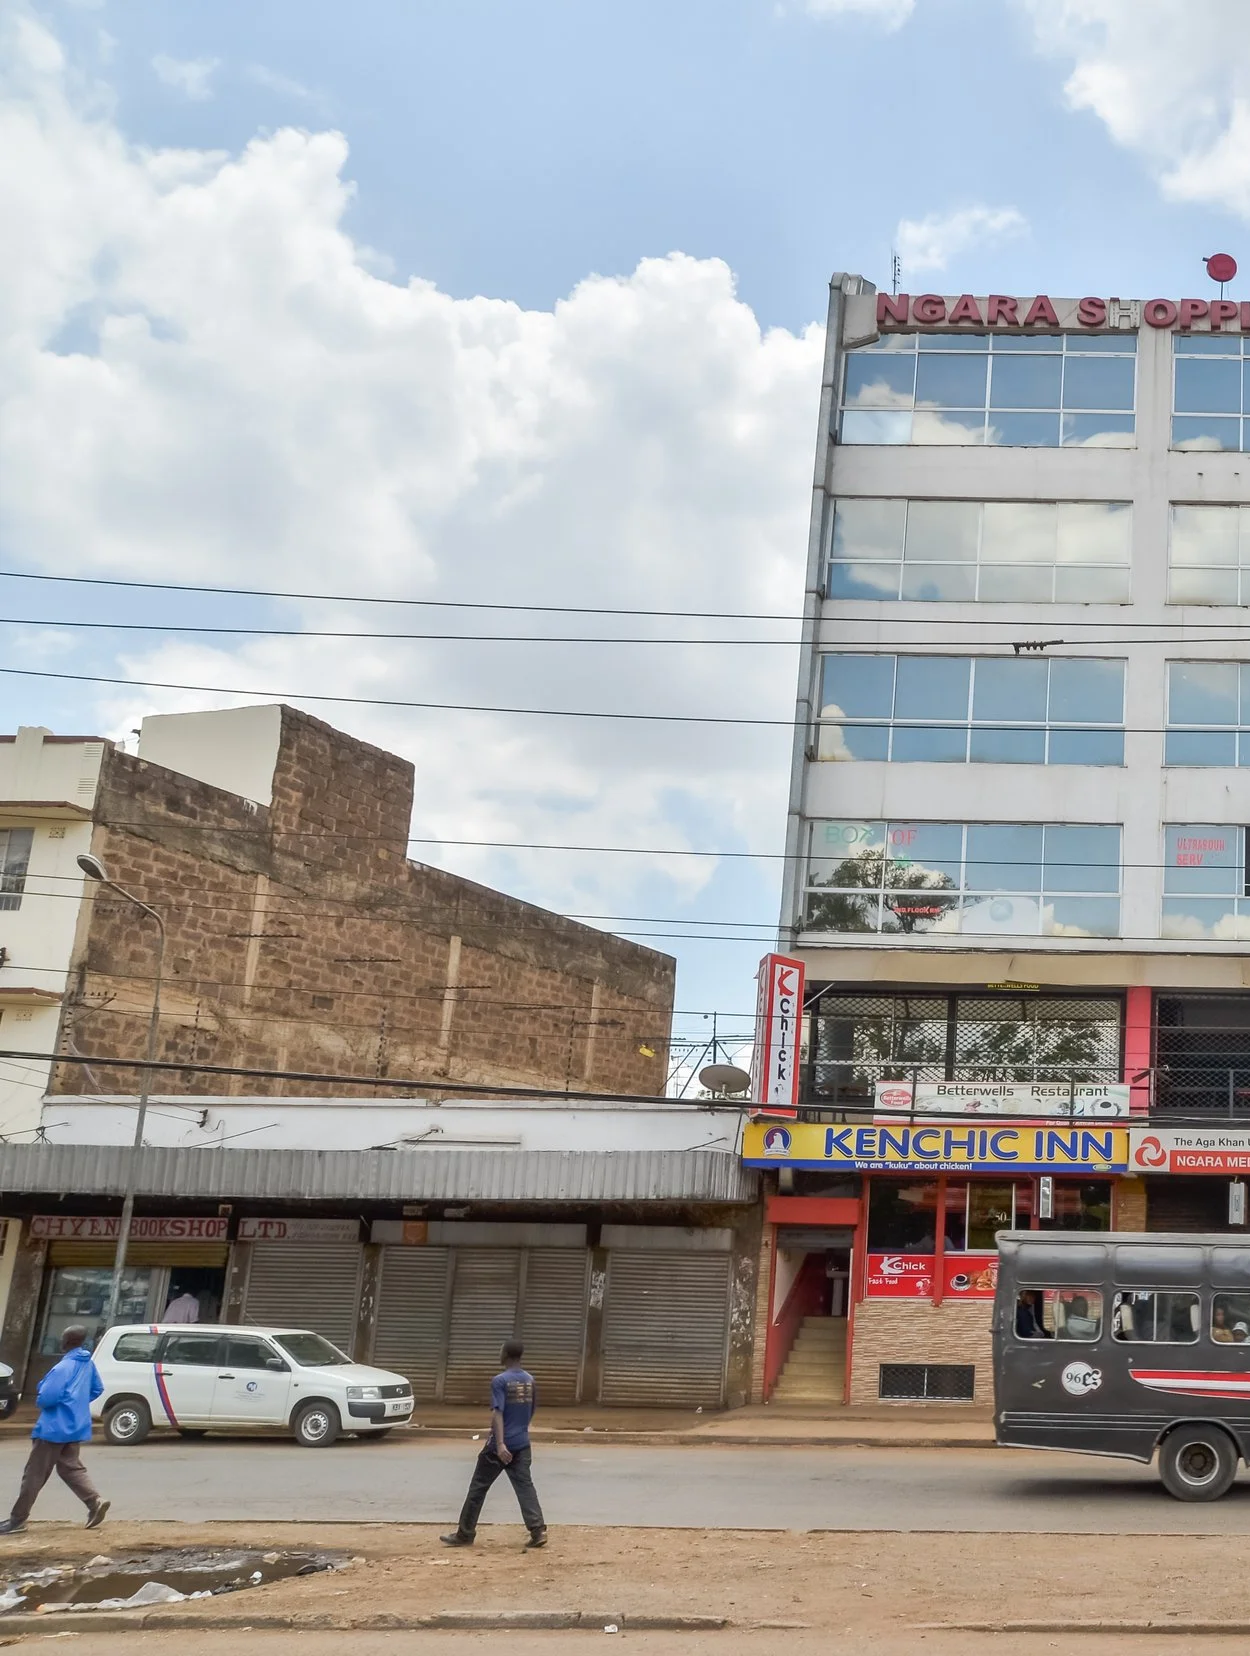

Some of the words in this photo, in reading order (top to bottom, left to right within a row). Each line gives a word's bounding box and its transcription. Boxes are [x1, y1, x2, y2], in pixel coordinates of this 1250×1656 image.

[876, 292, 1060, 327] NGARA
[892, 829, 917, 846] OF
[937, 1085, 1014, 1097] Betterwells
[1031, 1085, 1109, 1098] Restaurant
[824, 1127, 1019, 1160] KENCHIC
[1034, 1130, 1113, 1162] INN
[1174, 1137, 1193, 1147] The
[1195, 1138, 1216, 1149] Aga
[1218, 1137, 1245, 1148] Khan
[855, 1161, 868, 1169] We
[914, 1162, 938, 1170] about
[939, 1162, 973, 1171] chicken!
[1176, 1155, 1224, 1168] NGARA
[129, 1218, 228, 1238] BOOKSHOP
